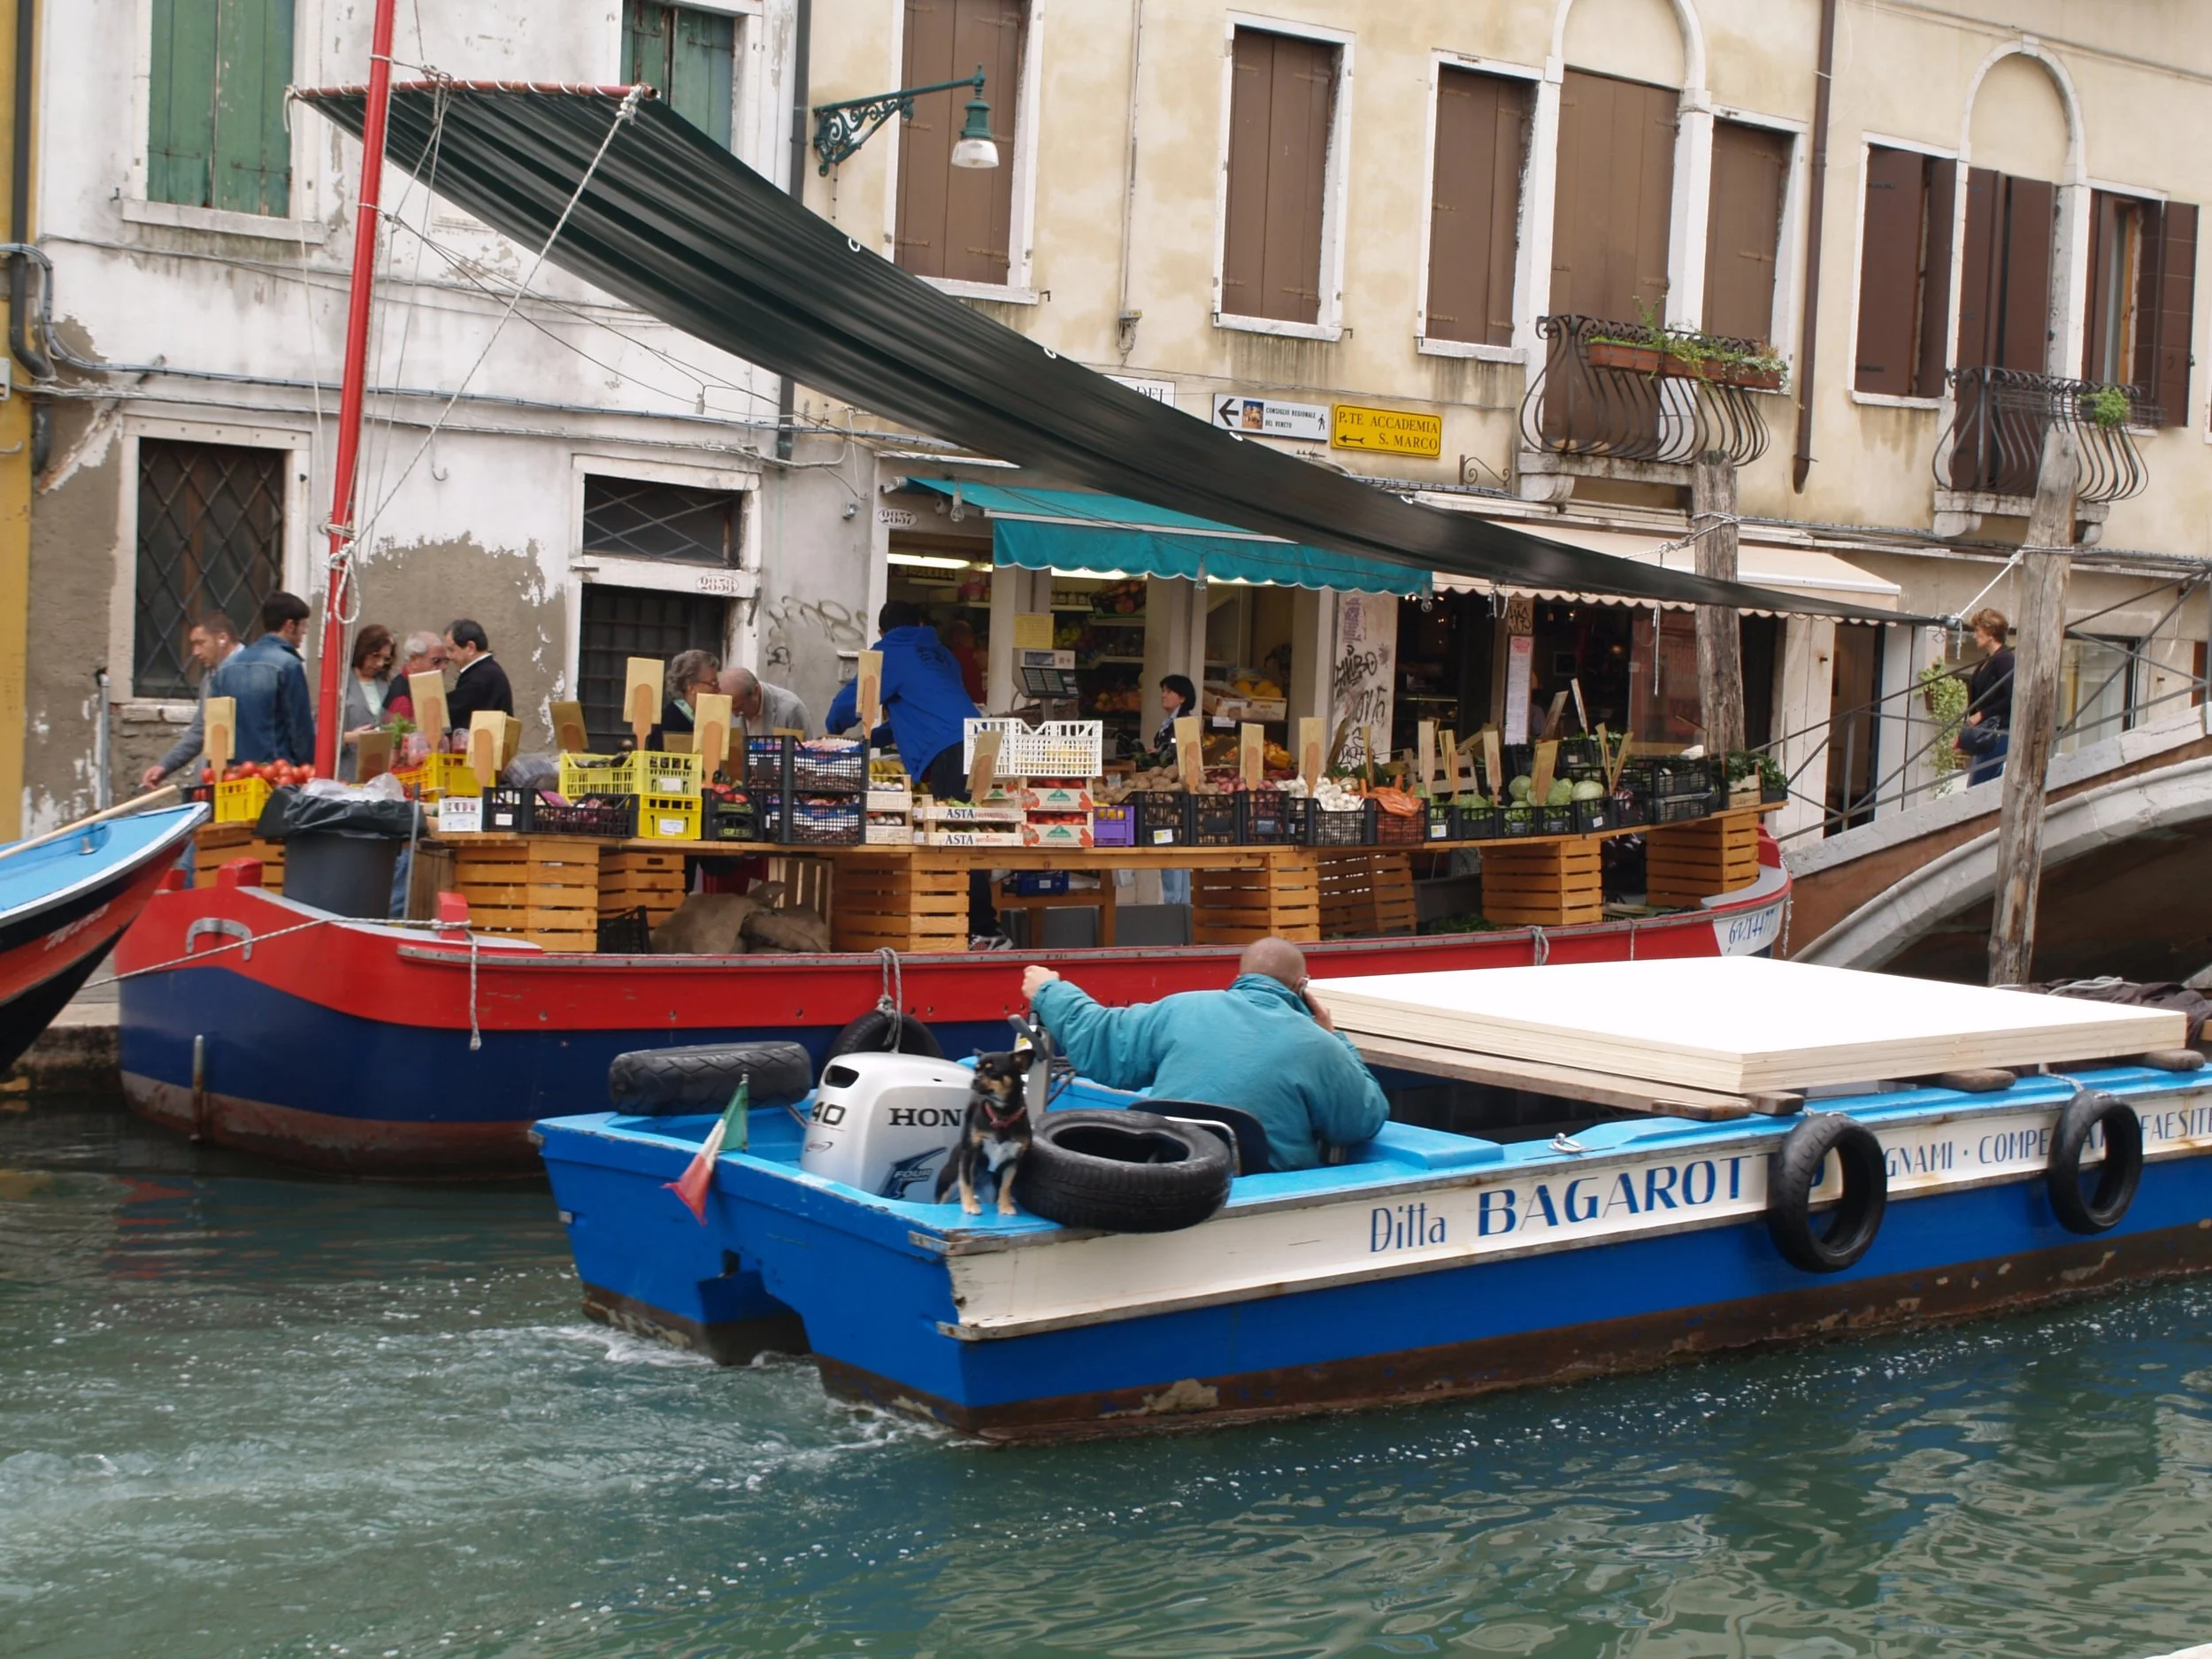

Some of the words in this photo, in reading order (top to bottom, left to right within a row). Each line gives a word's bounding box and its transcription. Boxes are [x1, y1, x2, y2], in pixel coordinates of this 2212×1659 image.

[1265, 407, 1290, 416] CONSIGLIO
[1292, 410, 1316, 419] REGIONALE
[1339, 411, 1363, 425] P.TE
[1370, 416, 1438, 434] ACCADEMIA
[1379, 432, 1389, 445] S.
[1394, 434, 1438, 449] MARCO
[946, 809, 974, 818] ASTA
[946, 834, 974, 845] ASTA
[811, 1101, 846, 1125] 40
[888, 1108, 962, 1126] HON
[1884, 1141, 1953, 1178] GNAMI
[894, 1169, 933, 1179] FOUR
[1370, 1202, 1446, 1253] Ditta
[1479, 1152, 1825, 1237] BAGAROT
